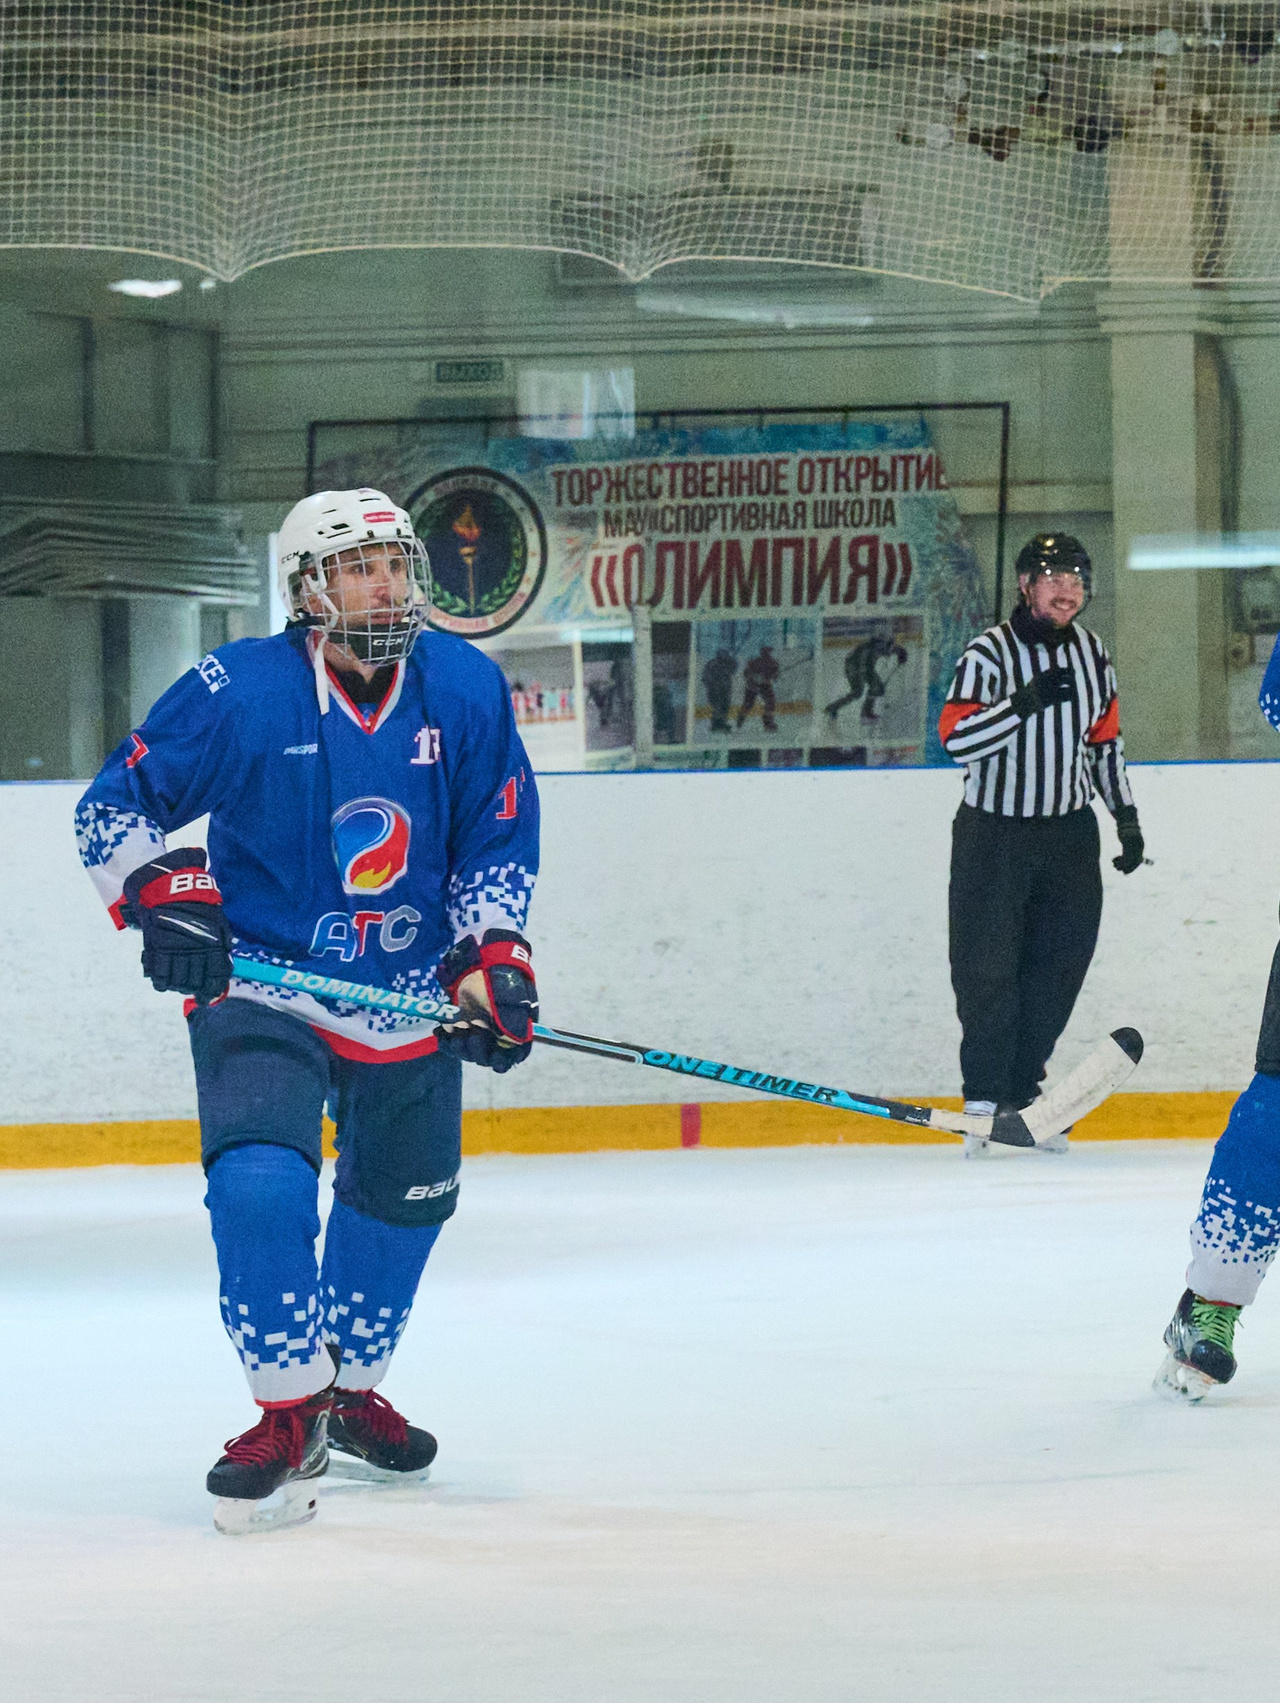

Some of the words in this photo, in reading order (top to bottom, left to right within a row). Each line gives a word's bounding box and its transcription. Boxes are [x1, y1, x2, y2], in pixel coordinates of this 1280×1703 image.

[550, 458, 789, 507] ТОРЖЕСТВЕННОЕ
[813, 498, 897, 530] ШКОЛА
[280, 969, 462, 1020] DOMINATOR
